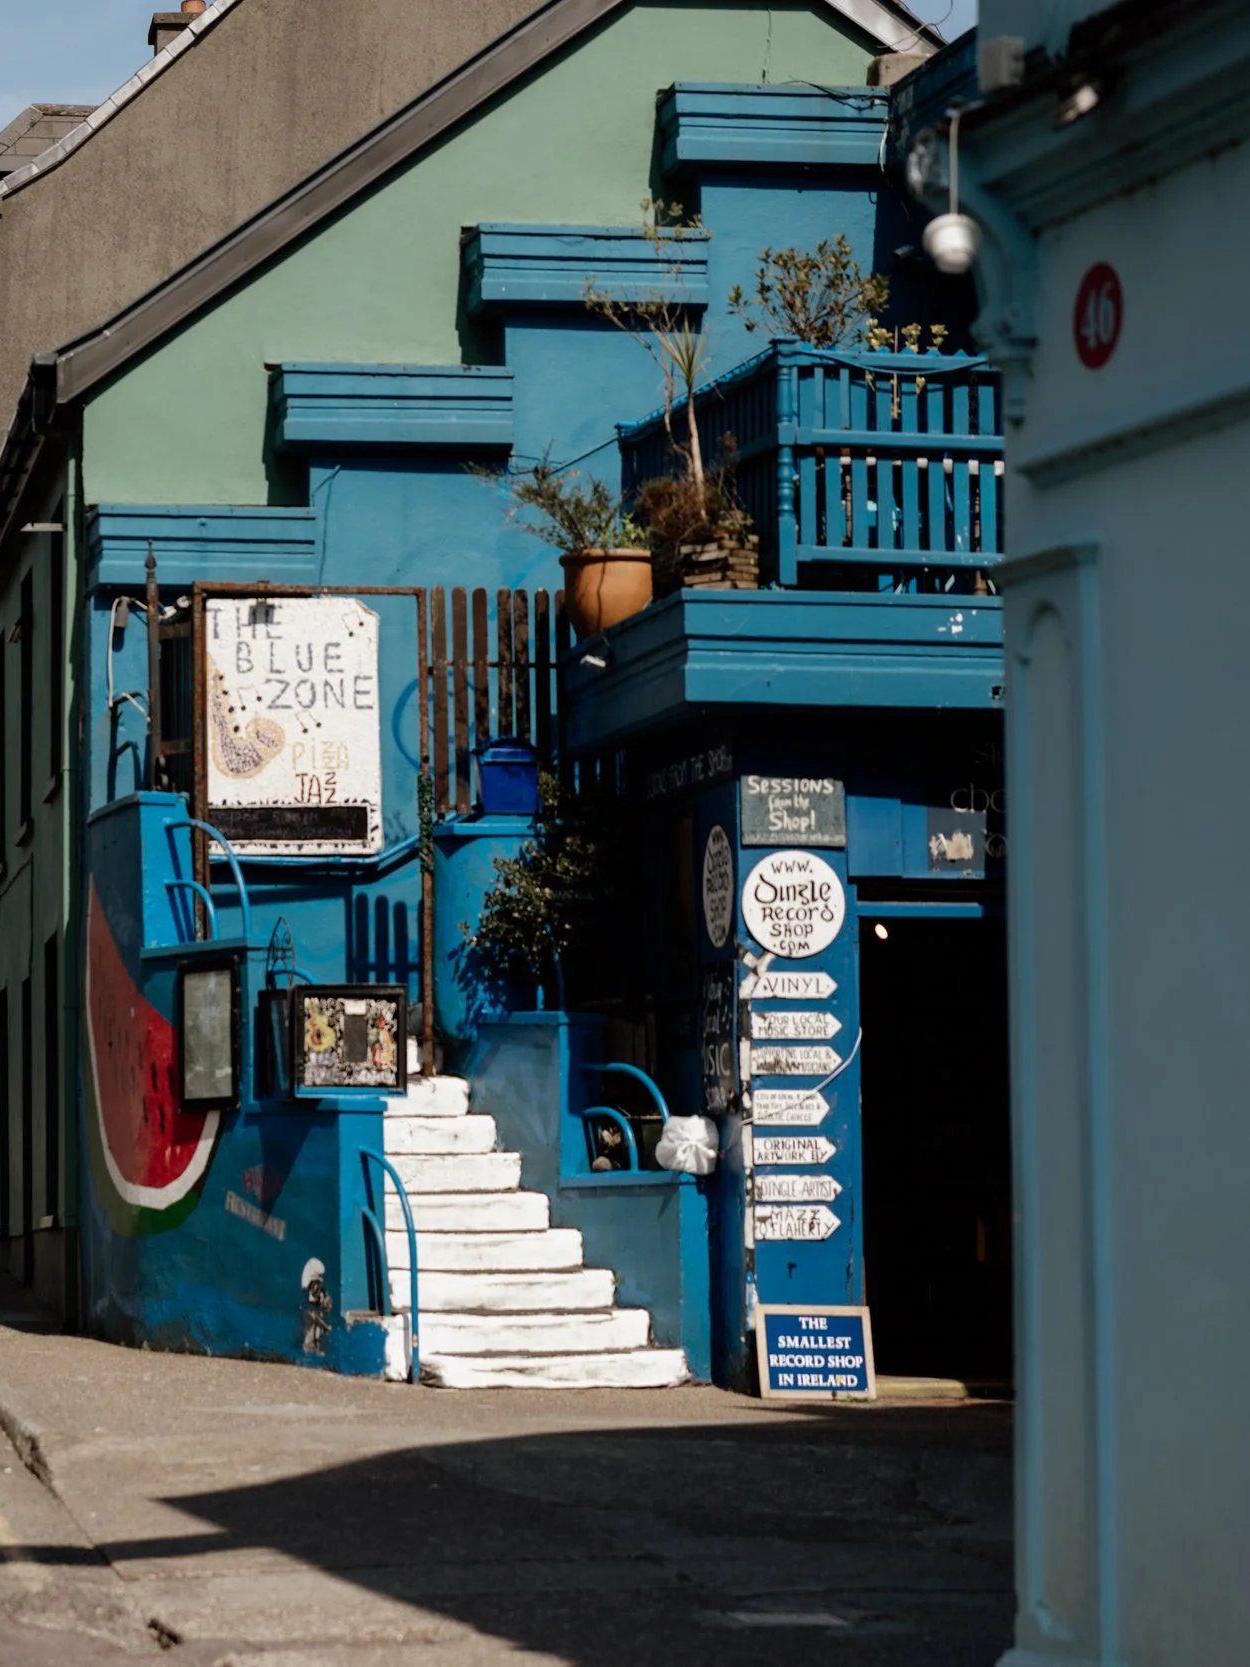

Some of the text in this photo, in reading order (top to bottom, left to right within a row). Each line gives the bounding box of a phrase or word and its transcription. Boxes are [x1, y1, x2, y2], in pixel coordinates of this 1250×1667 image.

[207, 605, 283, 639] THE
[236, 641, 344, 674] BLUE
[264, 675, 374, 710] ZONE
[294, 771, 337, 804] JAZZ
[768, 809, 816, 833] Shop!
[754, 873, 832, 906] Dingle
[766, 977, 825, 993] VINYL
[763, 1014, 829, 1025] YOUR LOCAL
[758, 1026, 829, 1037] MUSIC STORE
[799, 1049, 822, 1060] LOCAL
[764, 1139, 821, 1151] ORIGINAL
[757, 1151, 828, 1161] ARTWORK BY
[762, 1180, 797, 1198] DINGLE
[771, 1206, 820, 1221] MAZZ
[798, 1316, 828, 1330] THE
[777, 1335, 852, 1349] SMALLEST
[769, 1354, 864, 1369] RECORD SHOP
[778, 1373, 858, 1387] IN IRELAND
